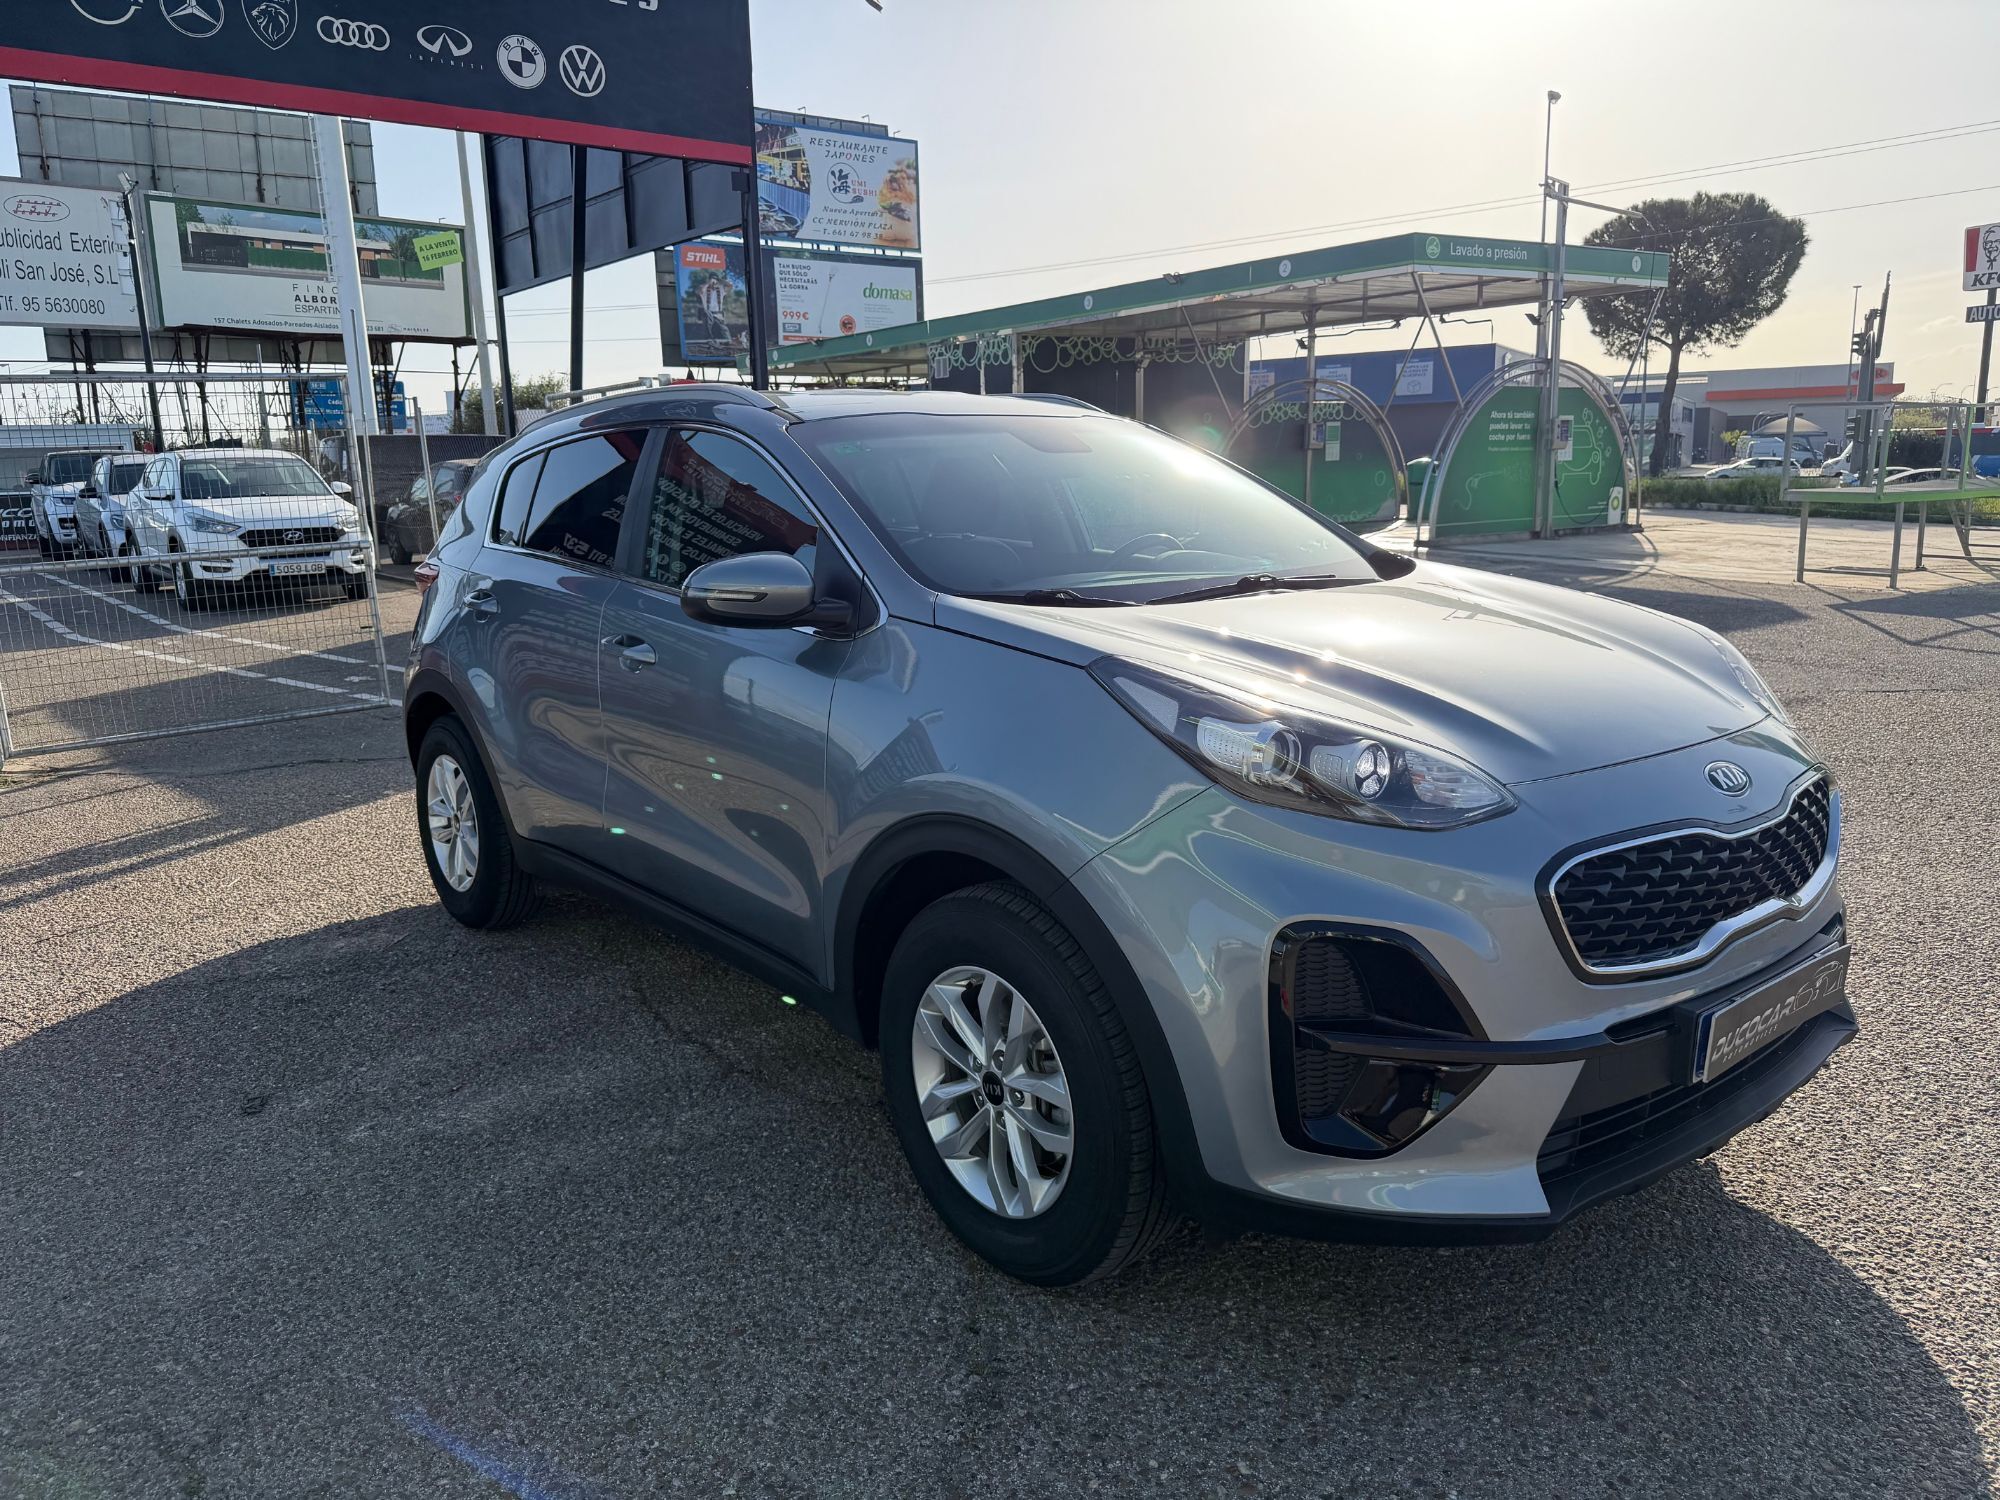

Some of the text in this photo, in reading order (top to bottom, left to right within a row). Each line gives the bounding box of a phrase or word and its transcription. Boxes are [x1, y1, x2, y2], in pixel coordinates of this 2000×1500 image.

[501, 36, 541, 57] BMW
[408, 53, 484, 71] INFINITI
[809, 137, 888, 155] RESTAURANTE
[824, 150, 876, 164] JAPONES
[830, 168, 851, 195] 海
[851, 179, 867, 188] UMI
[851, 187, 878, 197] SUSHI
[822, 205, 884, 218] Nueva Apertura
[867, 222, 894, 231] PLAZA
[425, 243, 435, 252] LA
[434, 239, 456, 249] VENTA
[1450, 243, 1528, 262] Lavado a presión
[422, 248, 459, 263] 16 FEBRERO
[686, 251, 721, 264] STIHL
[14, 259, 46, 281] San
[50, 261, 91, 287] José,
[791, 263, 812, 271] BUENO
[862, 281, 913, 301] domasa
[21, 296, 41, 313] 95
[45, 297, 105, 315] 5630080
[213, 317, 226, 325] 157
[1490, 410, 1507, 419] Ahora
[1489, 422, 1509, 431] puedes
[1509, 421, 1523, 430] lavar
[1488, 432, 1505, 441] coche
[1506, 433, 1516, 442] por
[276, 564, 302, 574] 5059
[1710, 767, 1747, 789] KIA
[1711, 995, 1796, 1063] DUCOCAR
[983, 1082, 1001, 1096] KIA
